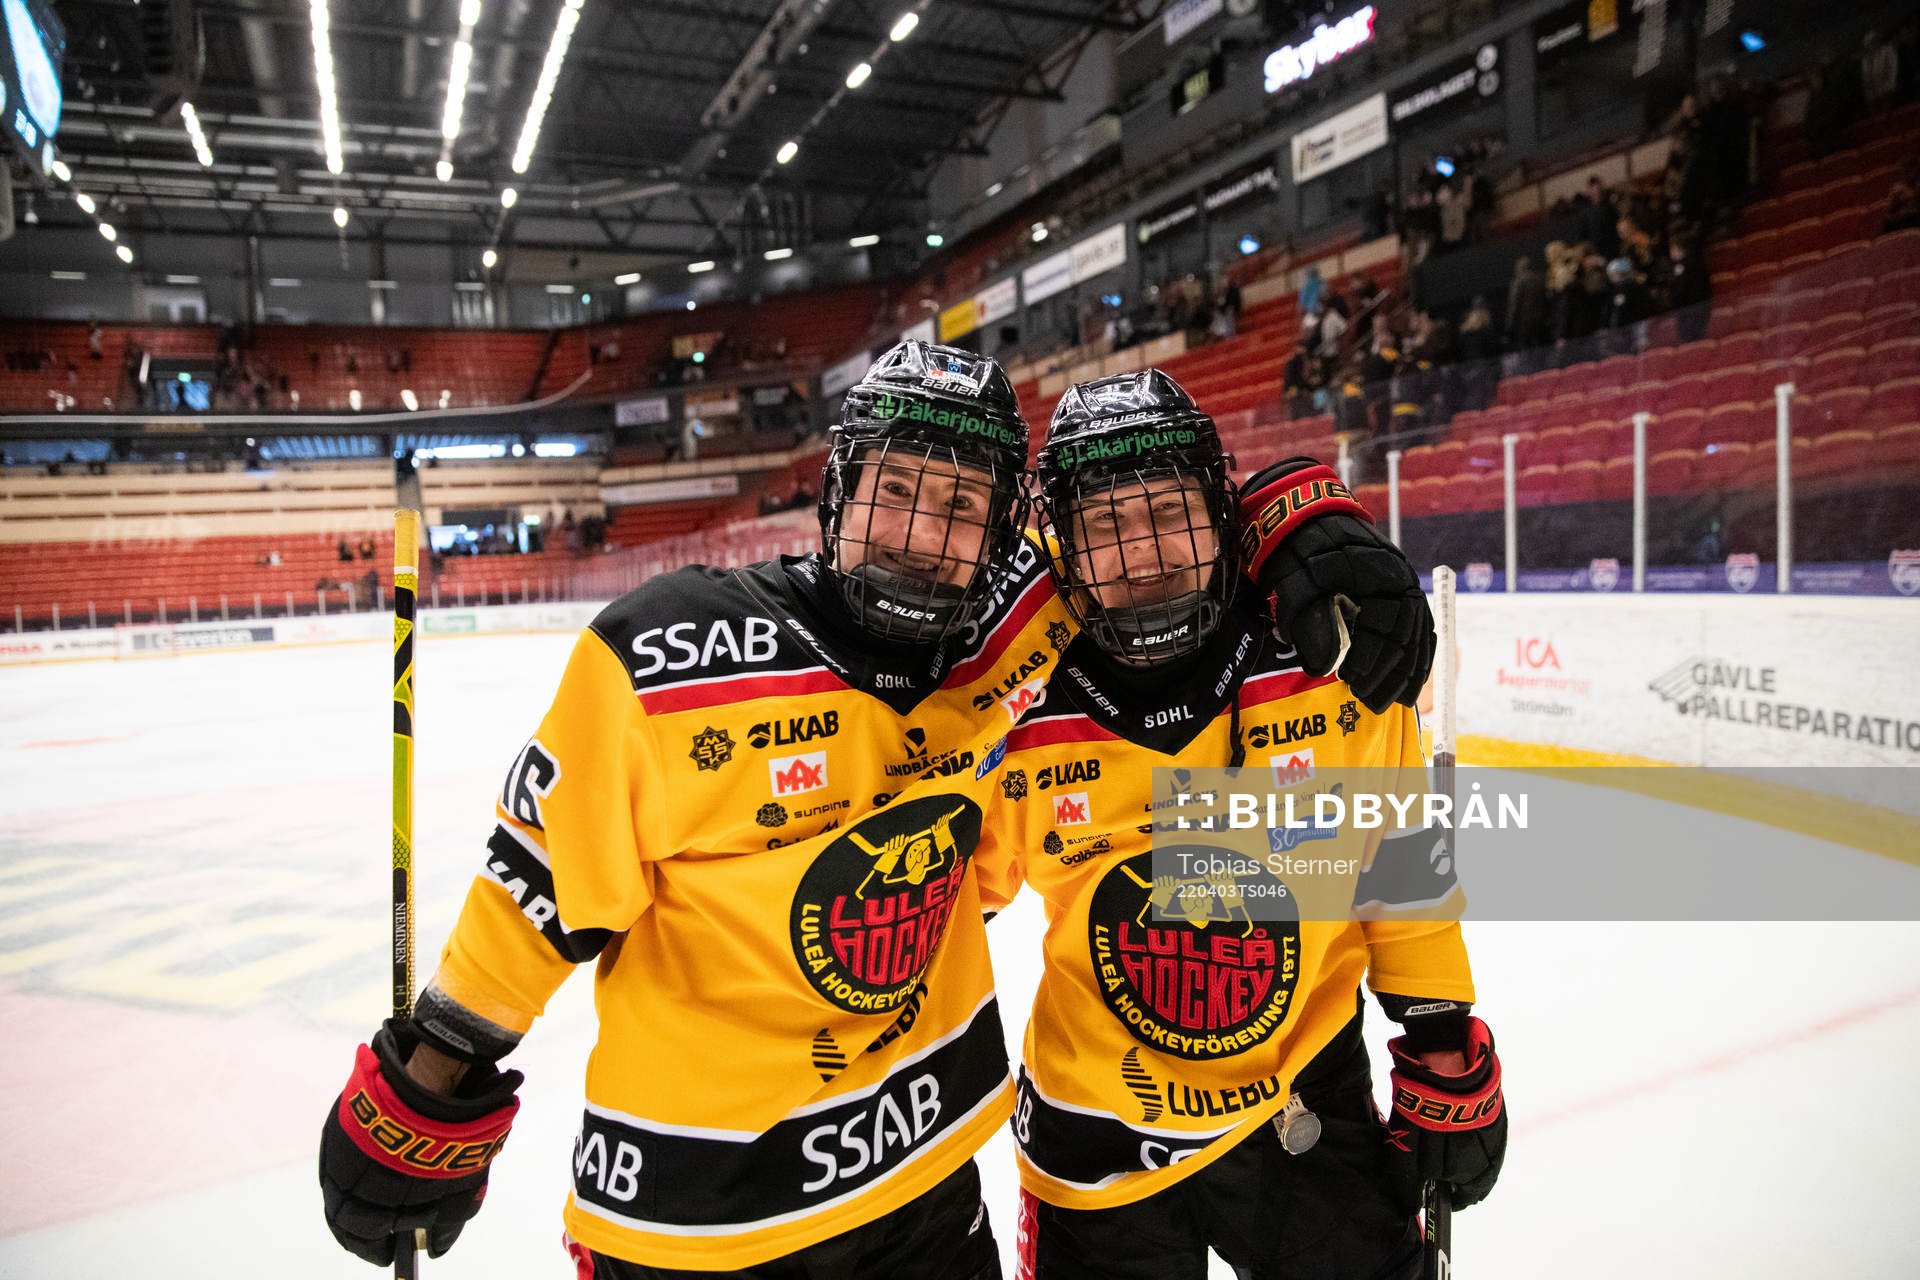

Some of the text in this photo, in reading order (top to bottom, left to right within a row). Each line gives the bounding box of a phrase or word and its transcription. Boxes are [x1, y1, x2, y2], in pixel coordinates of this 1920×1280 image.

[900, 399, 1016, 446] Läkarjouren
[1076, 430, 1196, 464] Läkarjouren
[632, 617, 778, 678] SSAB
[1516, 637, 1561, 671] ICA
[993, 651, 1048, 698] LKAB
[774, 710, 839, 746] LKAB
[1272, 713, 1327, 746] LKAB
[776, 758, 823, 794] MAX
[1055, 759, 1100, 786] LKAB
[1276, 755, 1311, 787] MAX
[1057, 796, 1087, 825] MAX
[395, 902, 406, 964] NIEMINEN
[801, 903, 833, 974] LULEÅ
[1118, 922, 1275, 967] LULEÅ
[1096, 925, 1295, 1054] LULEÅ HOCKEYFÖRENING 1977
[1120, 953, 1274, 1030] HOCKEY
[801, 1073, 941, 1193] SSAB
